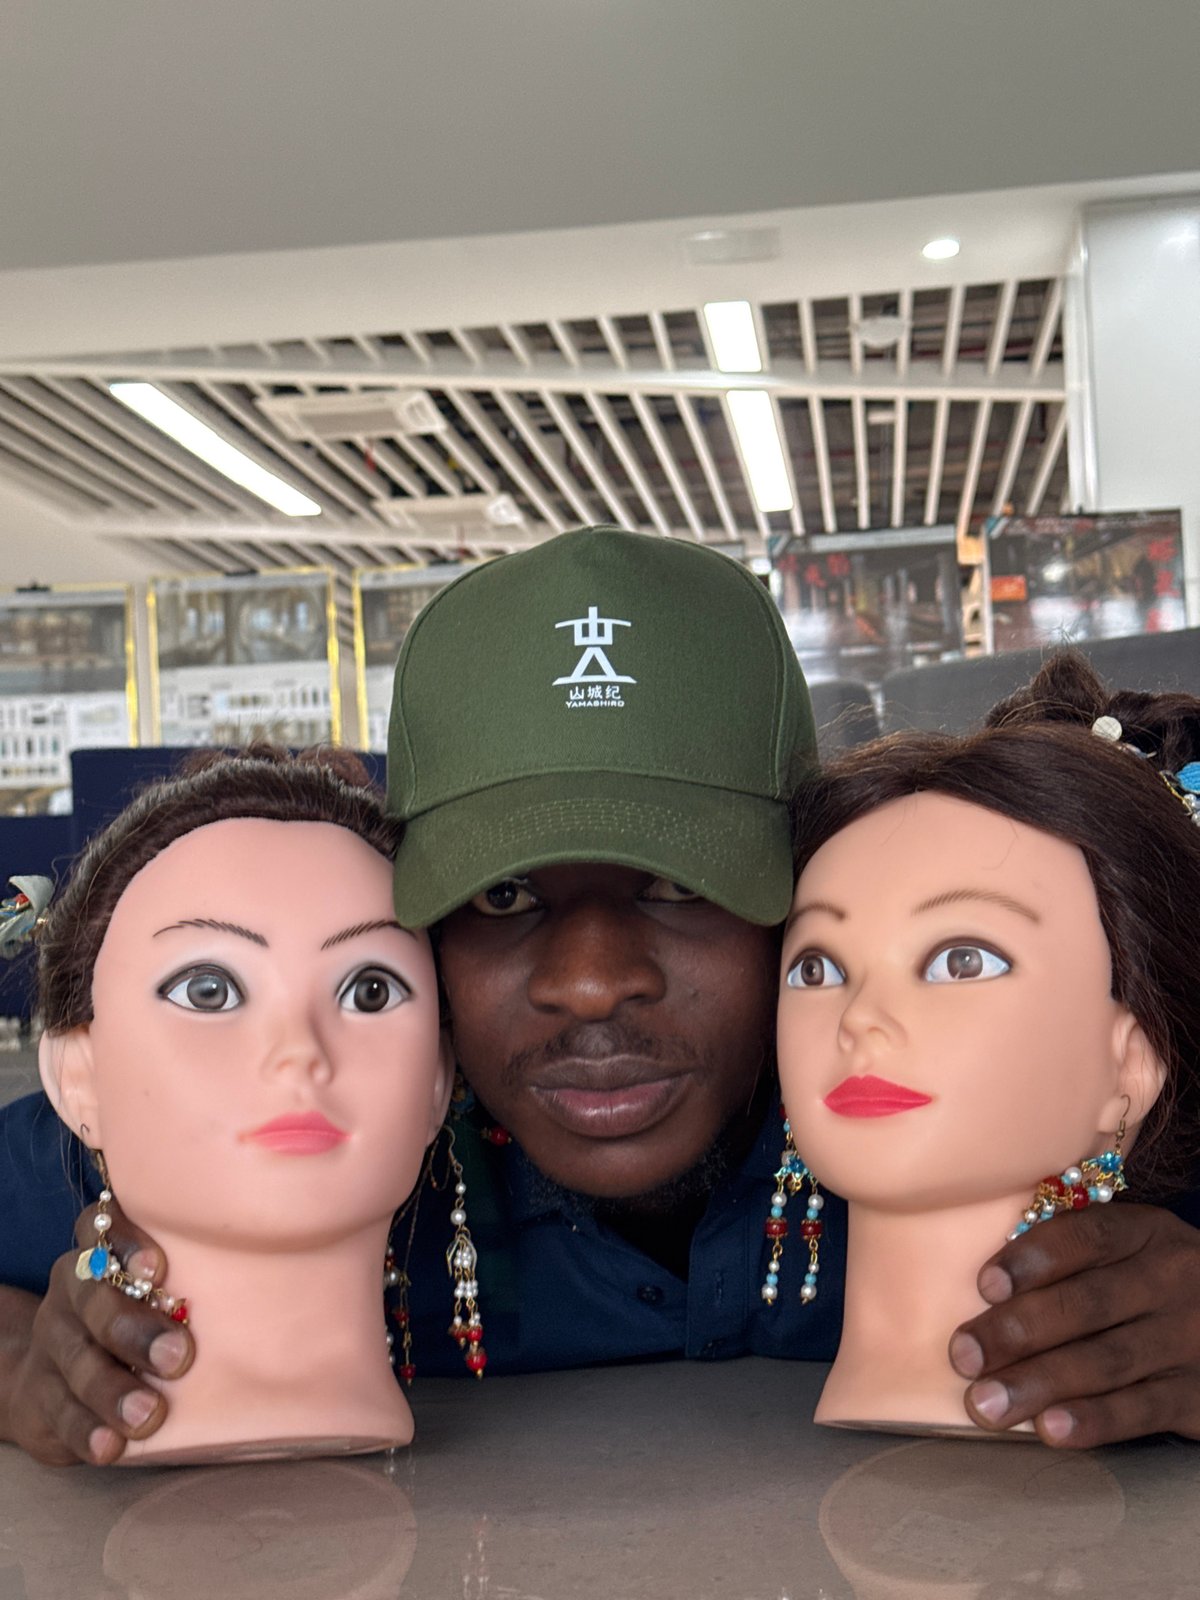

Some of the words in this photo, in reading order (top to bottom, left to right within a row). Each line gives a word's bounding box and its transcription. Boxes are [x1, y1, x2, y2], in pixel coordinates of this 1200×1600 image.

[569, 685, 621, 700] 山城纪
[565, 700, 625, 709] YAMASHIRO
